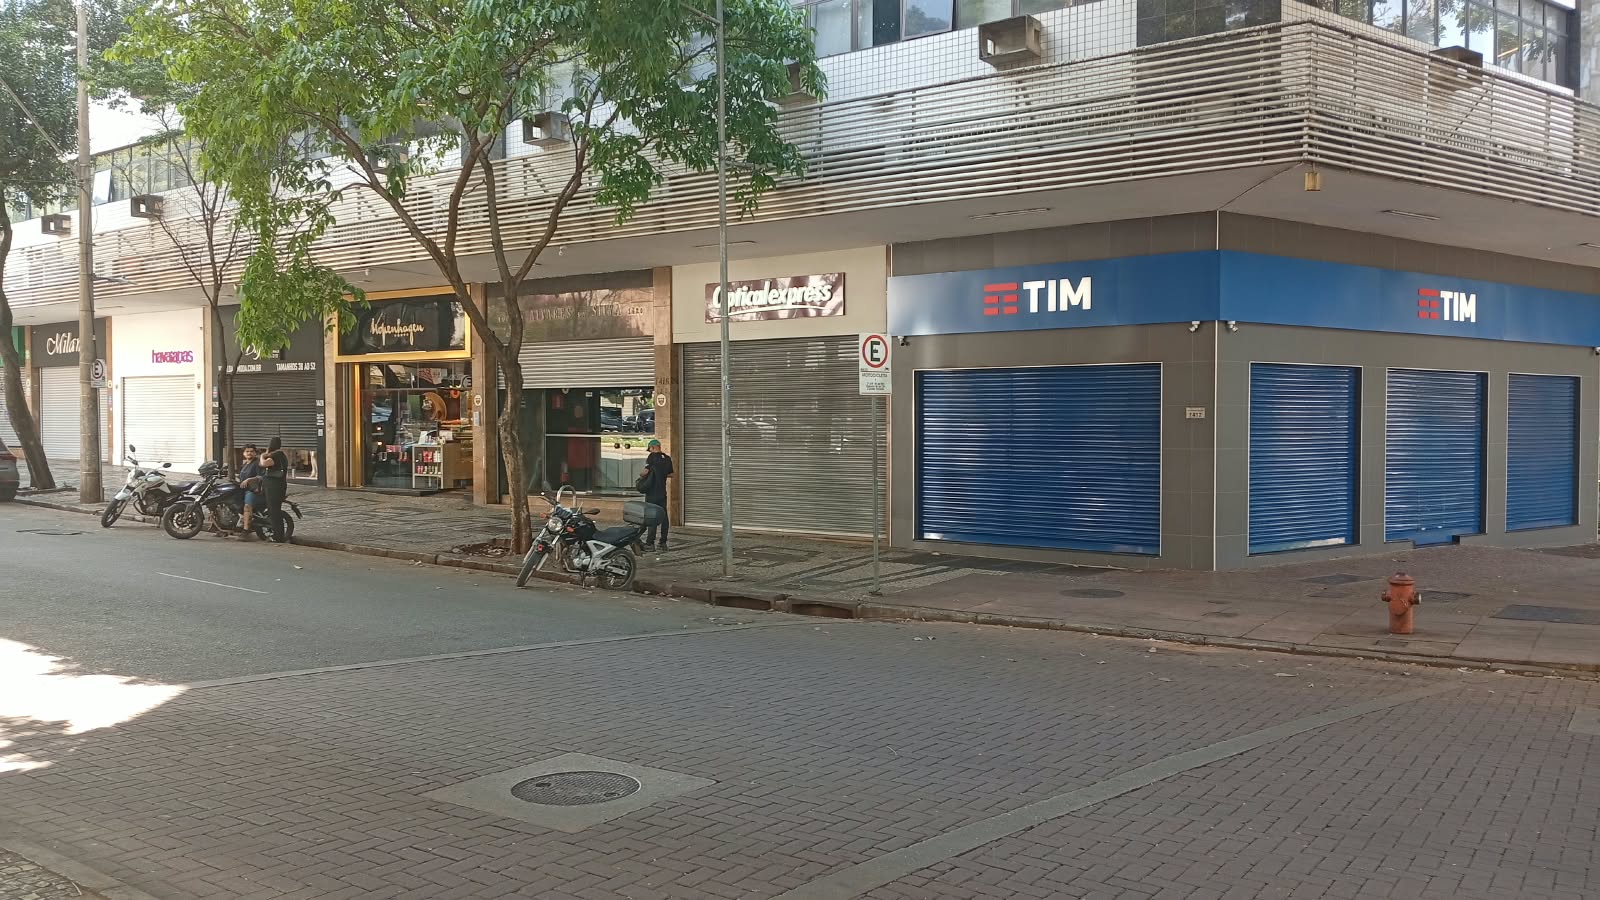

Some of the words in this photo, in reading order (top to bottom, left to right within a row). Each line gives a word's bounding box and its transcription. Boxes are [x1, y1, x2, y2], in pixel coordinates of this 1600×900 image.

[1023, 277, 1092, 313] TIM
[1440, 291, 1476, 323] TIM
[370, 312, 424, 346] Kopenhagen
[870, 341, 881, 361] E
